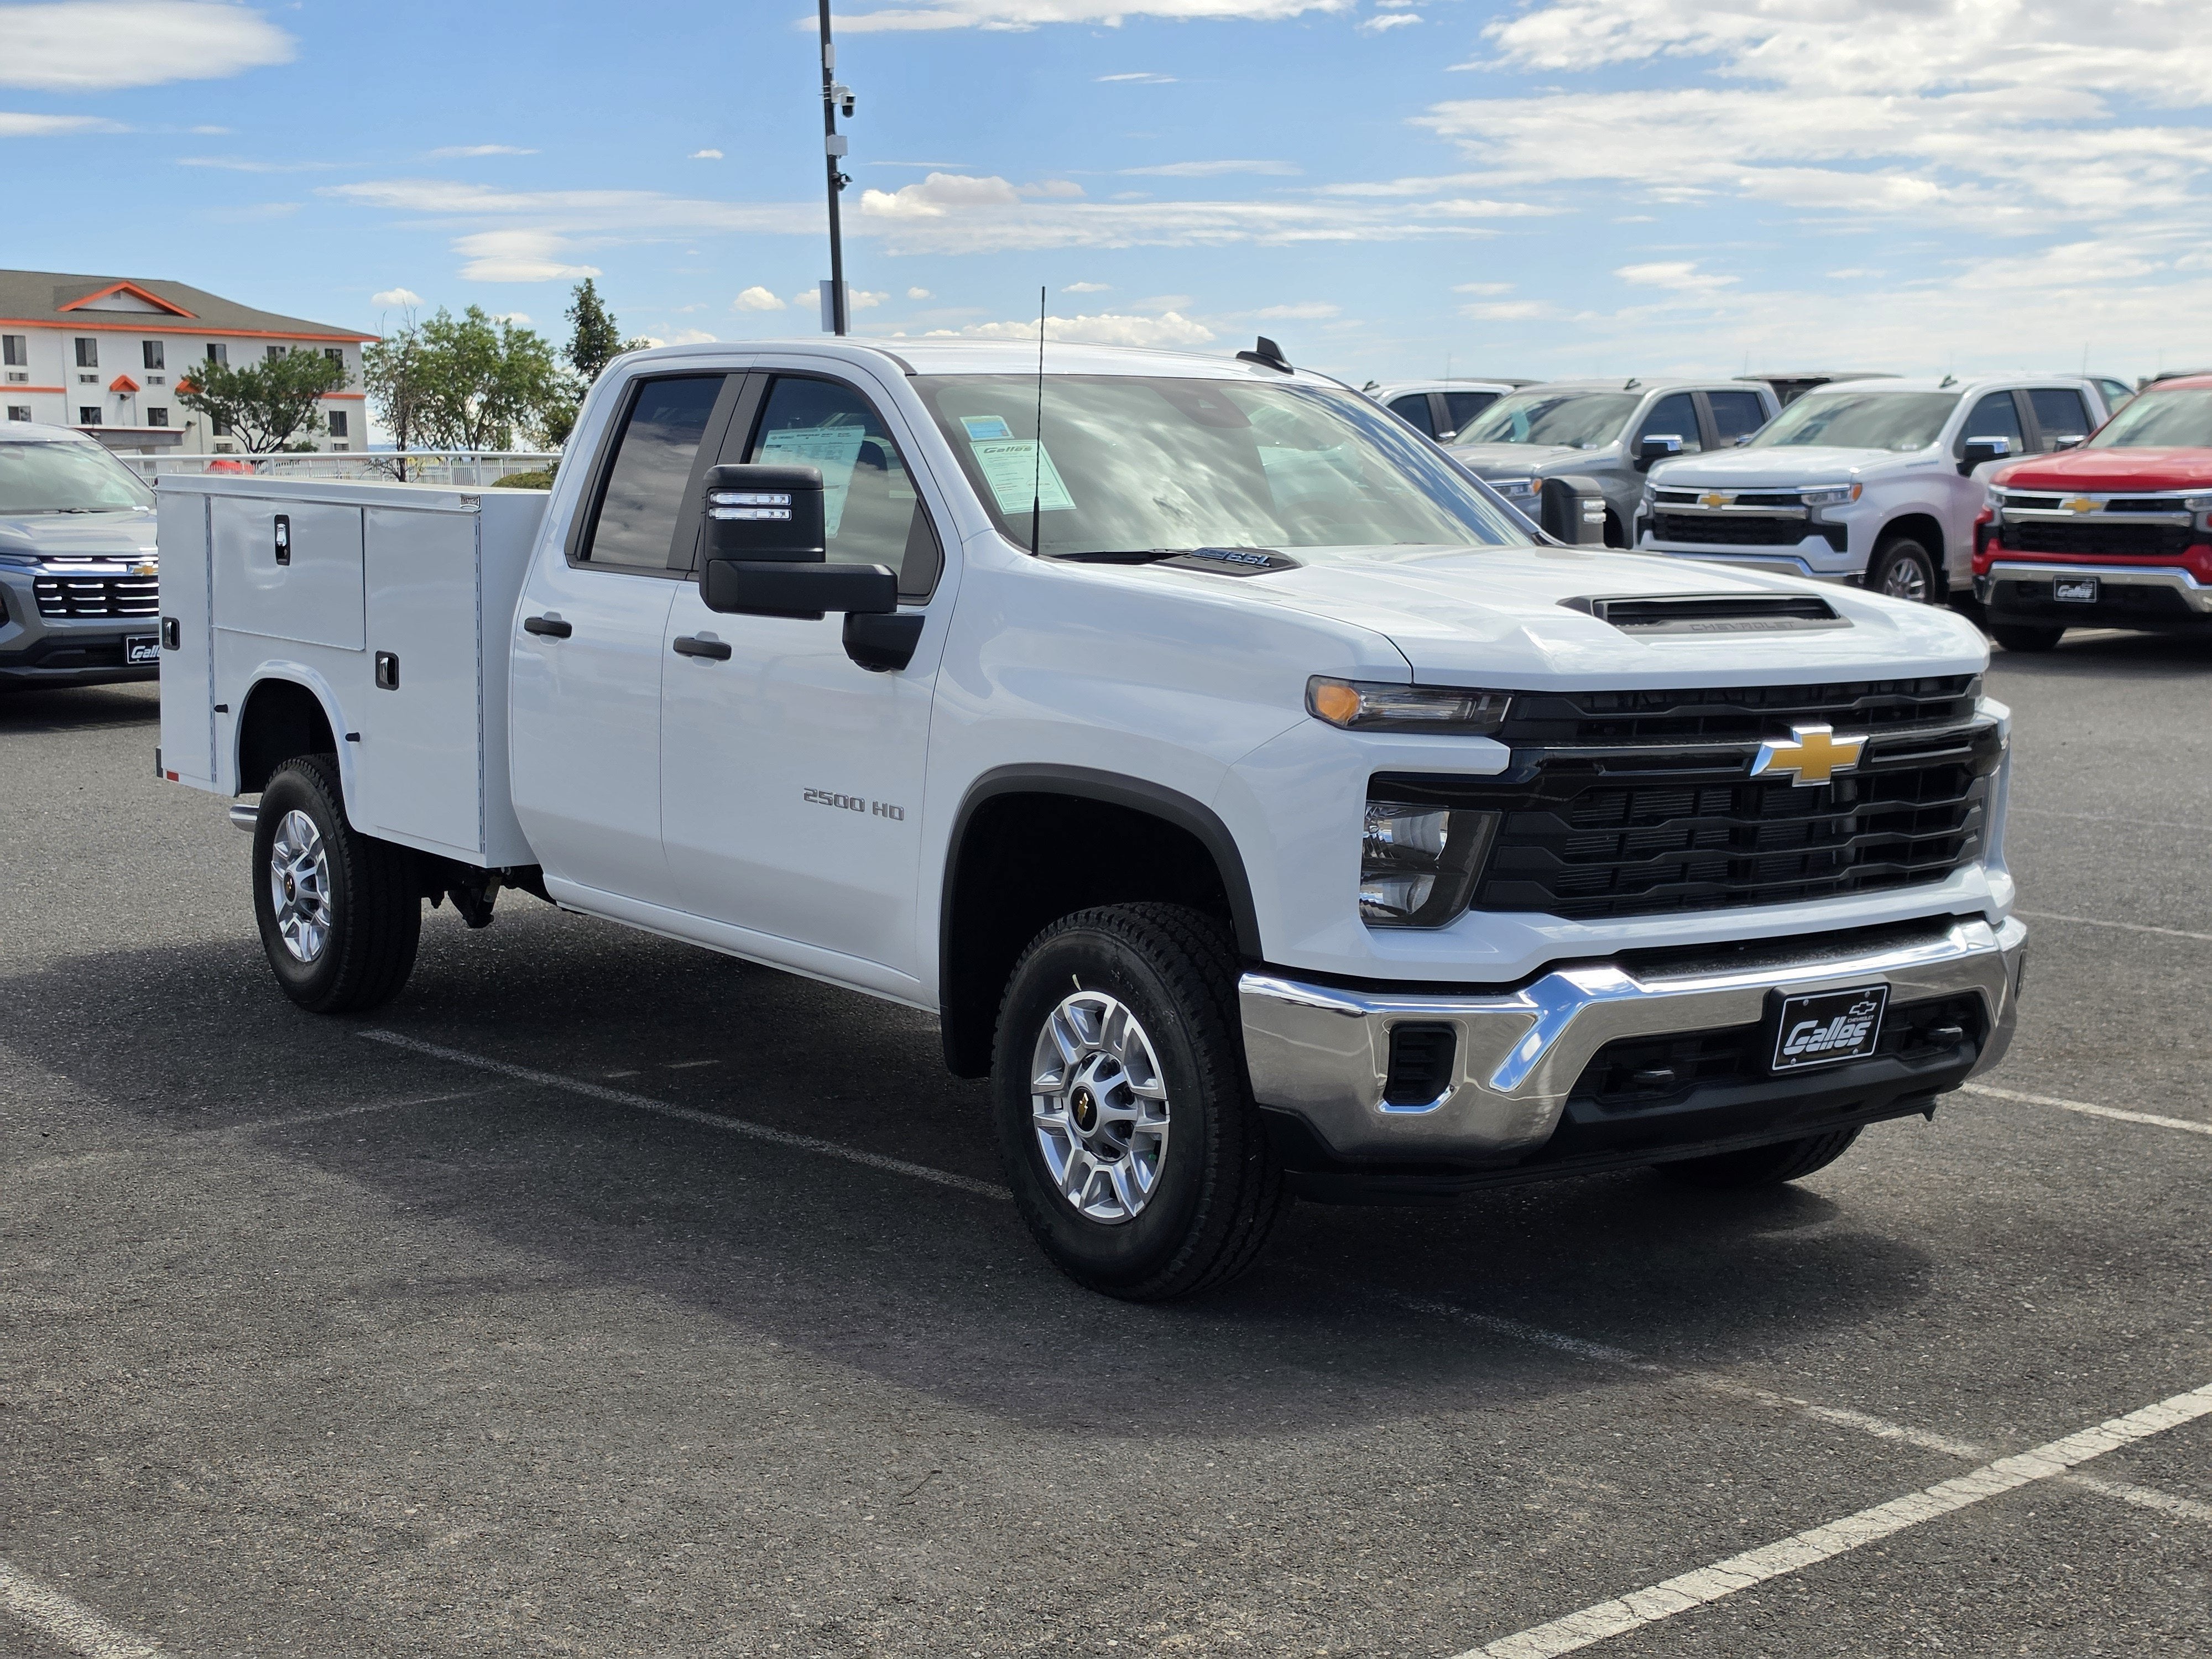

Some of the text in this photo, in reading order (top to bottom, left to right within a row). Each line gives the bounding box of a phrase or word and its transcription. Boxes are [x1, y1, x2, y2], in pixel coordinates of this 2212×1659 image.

[1689, 621, 1794, 632] CHEVROLET
[131, 645, 160, 659] Gall
[804, 787, 905, 821] 2500 HD
[1783, 1016, 1872, 1056] Galles
